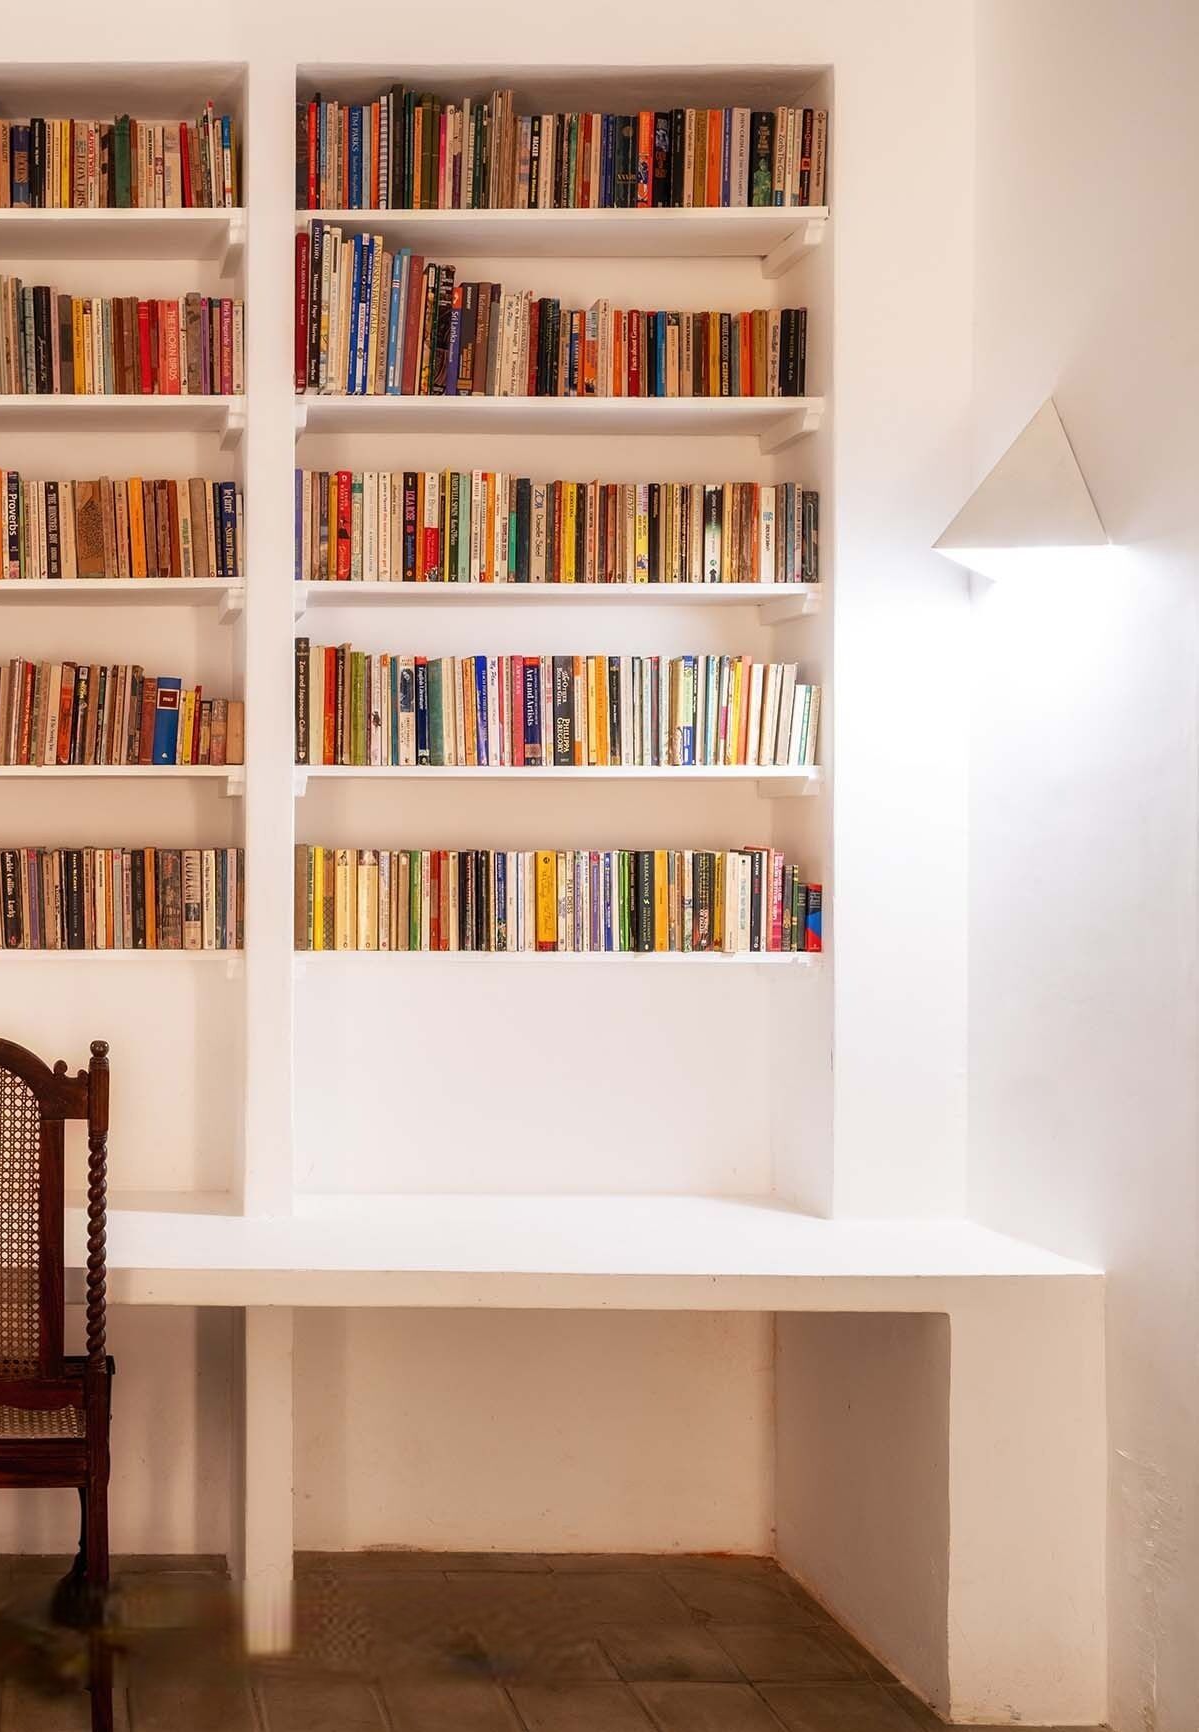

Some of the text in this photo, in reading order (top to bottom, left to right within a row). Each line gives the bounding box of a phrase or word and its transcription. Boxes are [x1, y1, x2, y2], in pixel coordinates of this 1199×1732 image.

[352, 111, 360, 126] TIM
[351, 128, 359, 152] PARKS
[777, 134, 785, 152] Zorba
[77, 155, 86, 181] LEON
[776, 165, 784, 184] Greek
[371, 290, 379, 311] FAIRY
[478, 294, 486, 322] Relative
[546, 301, 554, 320] JOHN
[449, 322, 458, 343] Lanka
[167, 310, 177, 380] THE THORN BIRDS
[8, 494, 18, 536] Proverbs
[223, 495, 234, 513] Carré
[406, 490, 415, 521] LOLA ROSE
[426, 484, 436, 527] Bill Bryson
[489, 660, 497, 670] My
[527, 699, 535, 726] Artists
[6, 852, 14, 872] Jackie
[185, 856, 195, 901] LUDLUM
